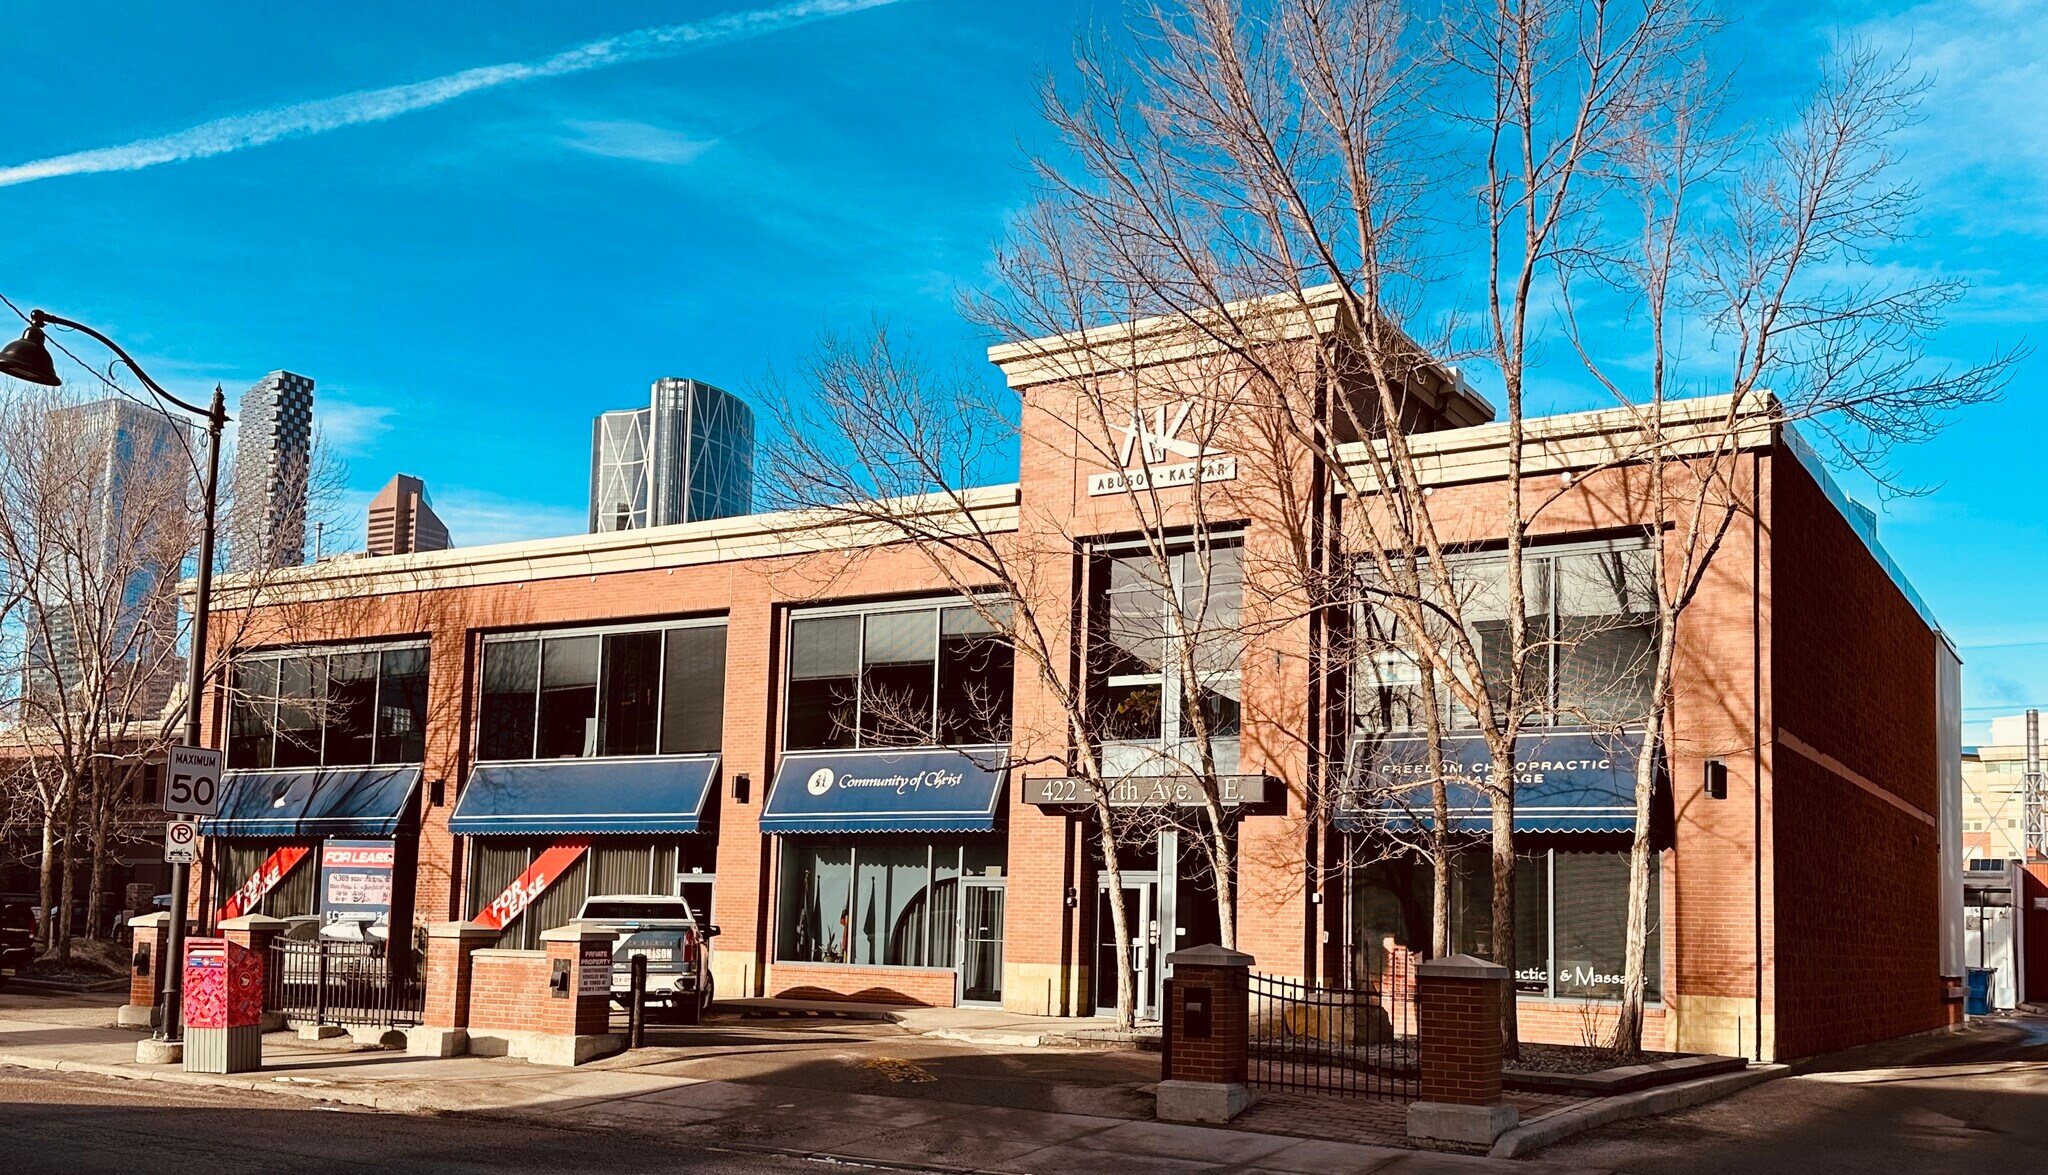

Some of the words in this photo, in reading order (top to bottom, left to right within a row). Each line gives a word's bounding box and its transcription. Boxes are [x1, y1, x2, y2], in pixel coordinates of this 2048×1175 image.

[1097, 472, 1153, 490] ABUGO
[1169, 463, 1225, 481] KASAR
[175, 753, 216, 767] MAXIMUM
[1472, 759, 1611, 774] CHOPRACTIC
[170, 773, 215, 806] 50
[838, 773, 909, 795] Community
[909, 770, 926, 792] of
[925, 769, 963, 789] Christ
[1041, 780, 1077, 801] 422
[1108, 779, 1138, 800] 1th
[1149, 779, 1192, 800] Ave.
[325, 850, 351, 863] FOR
[235, 870, 260, 909] FOR
[243, 864, 281, 916] LEASE
[491, 880, 522, 918] FOR
[500, 872, 546, 928] LEASE
[585, 950, 608, 958] PRIVATE
[1560, 969, 1573, 982] &
[1575, 966, 1649, 987] Massae
